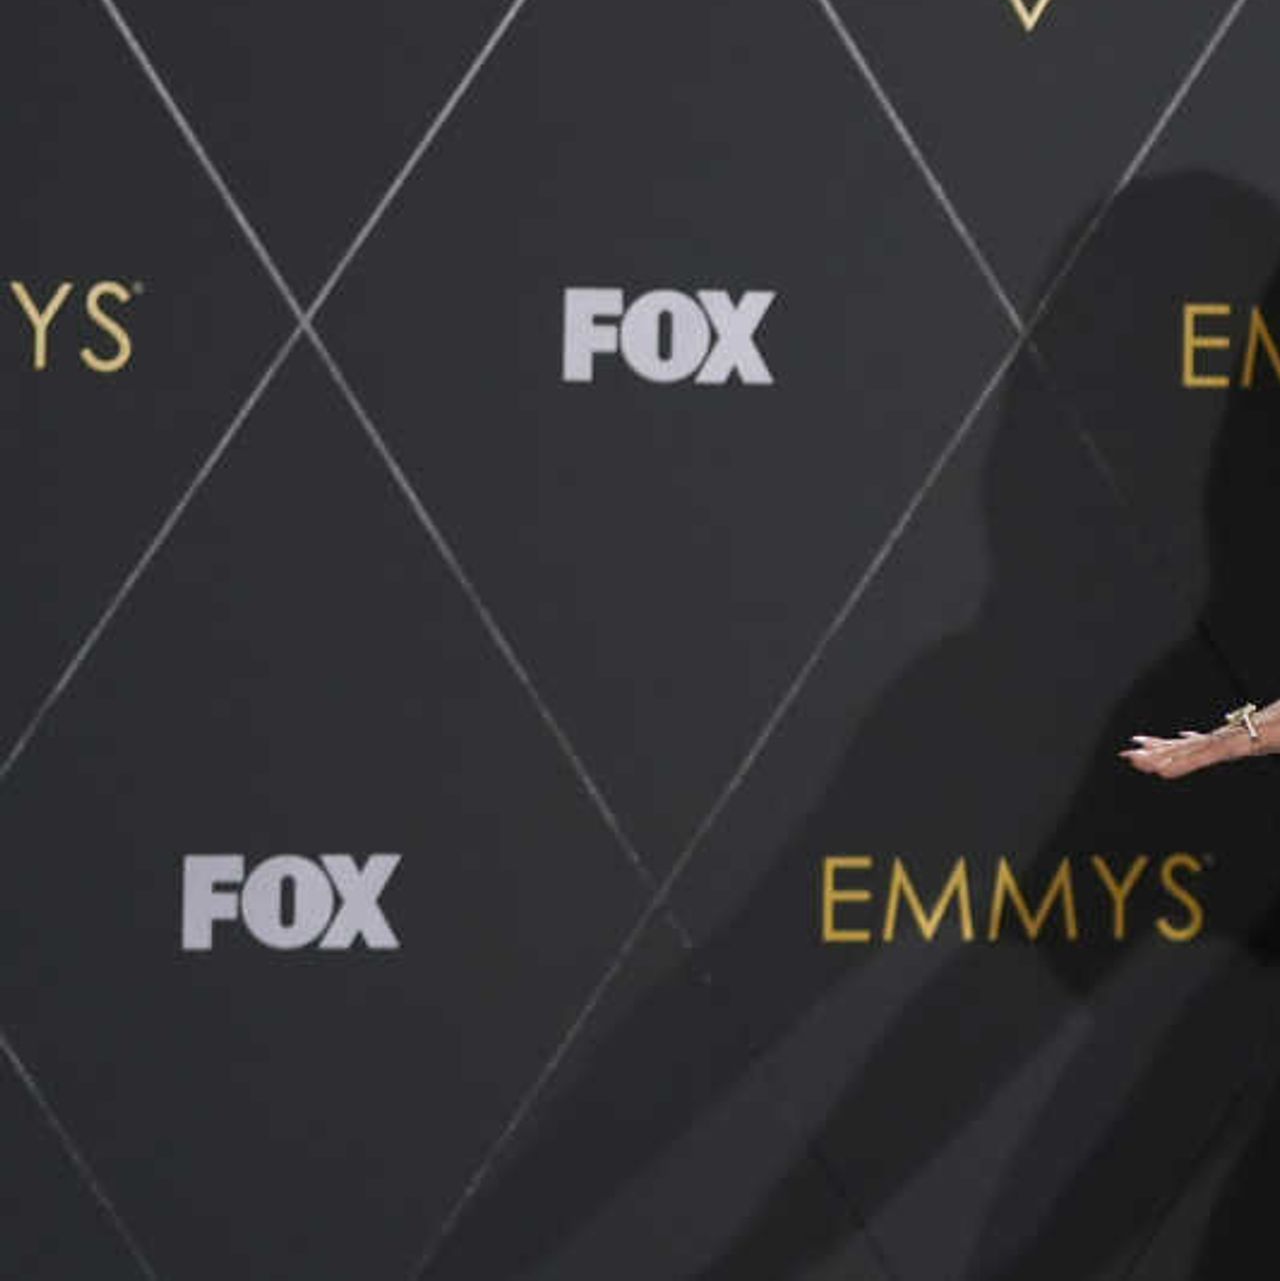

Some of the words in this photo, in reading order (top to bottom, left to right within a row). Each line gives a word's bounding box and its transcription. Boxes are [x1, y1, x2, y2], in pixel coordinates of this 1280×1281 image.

[562, 286, 776, 385] FOX
[181, 852, 402, 951] FOX
[821, 854, 1203, 943] EMMYS
